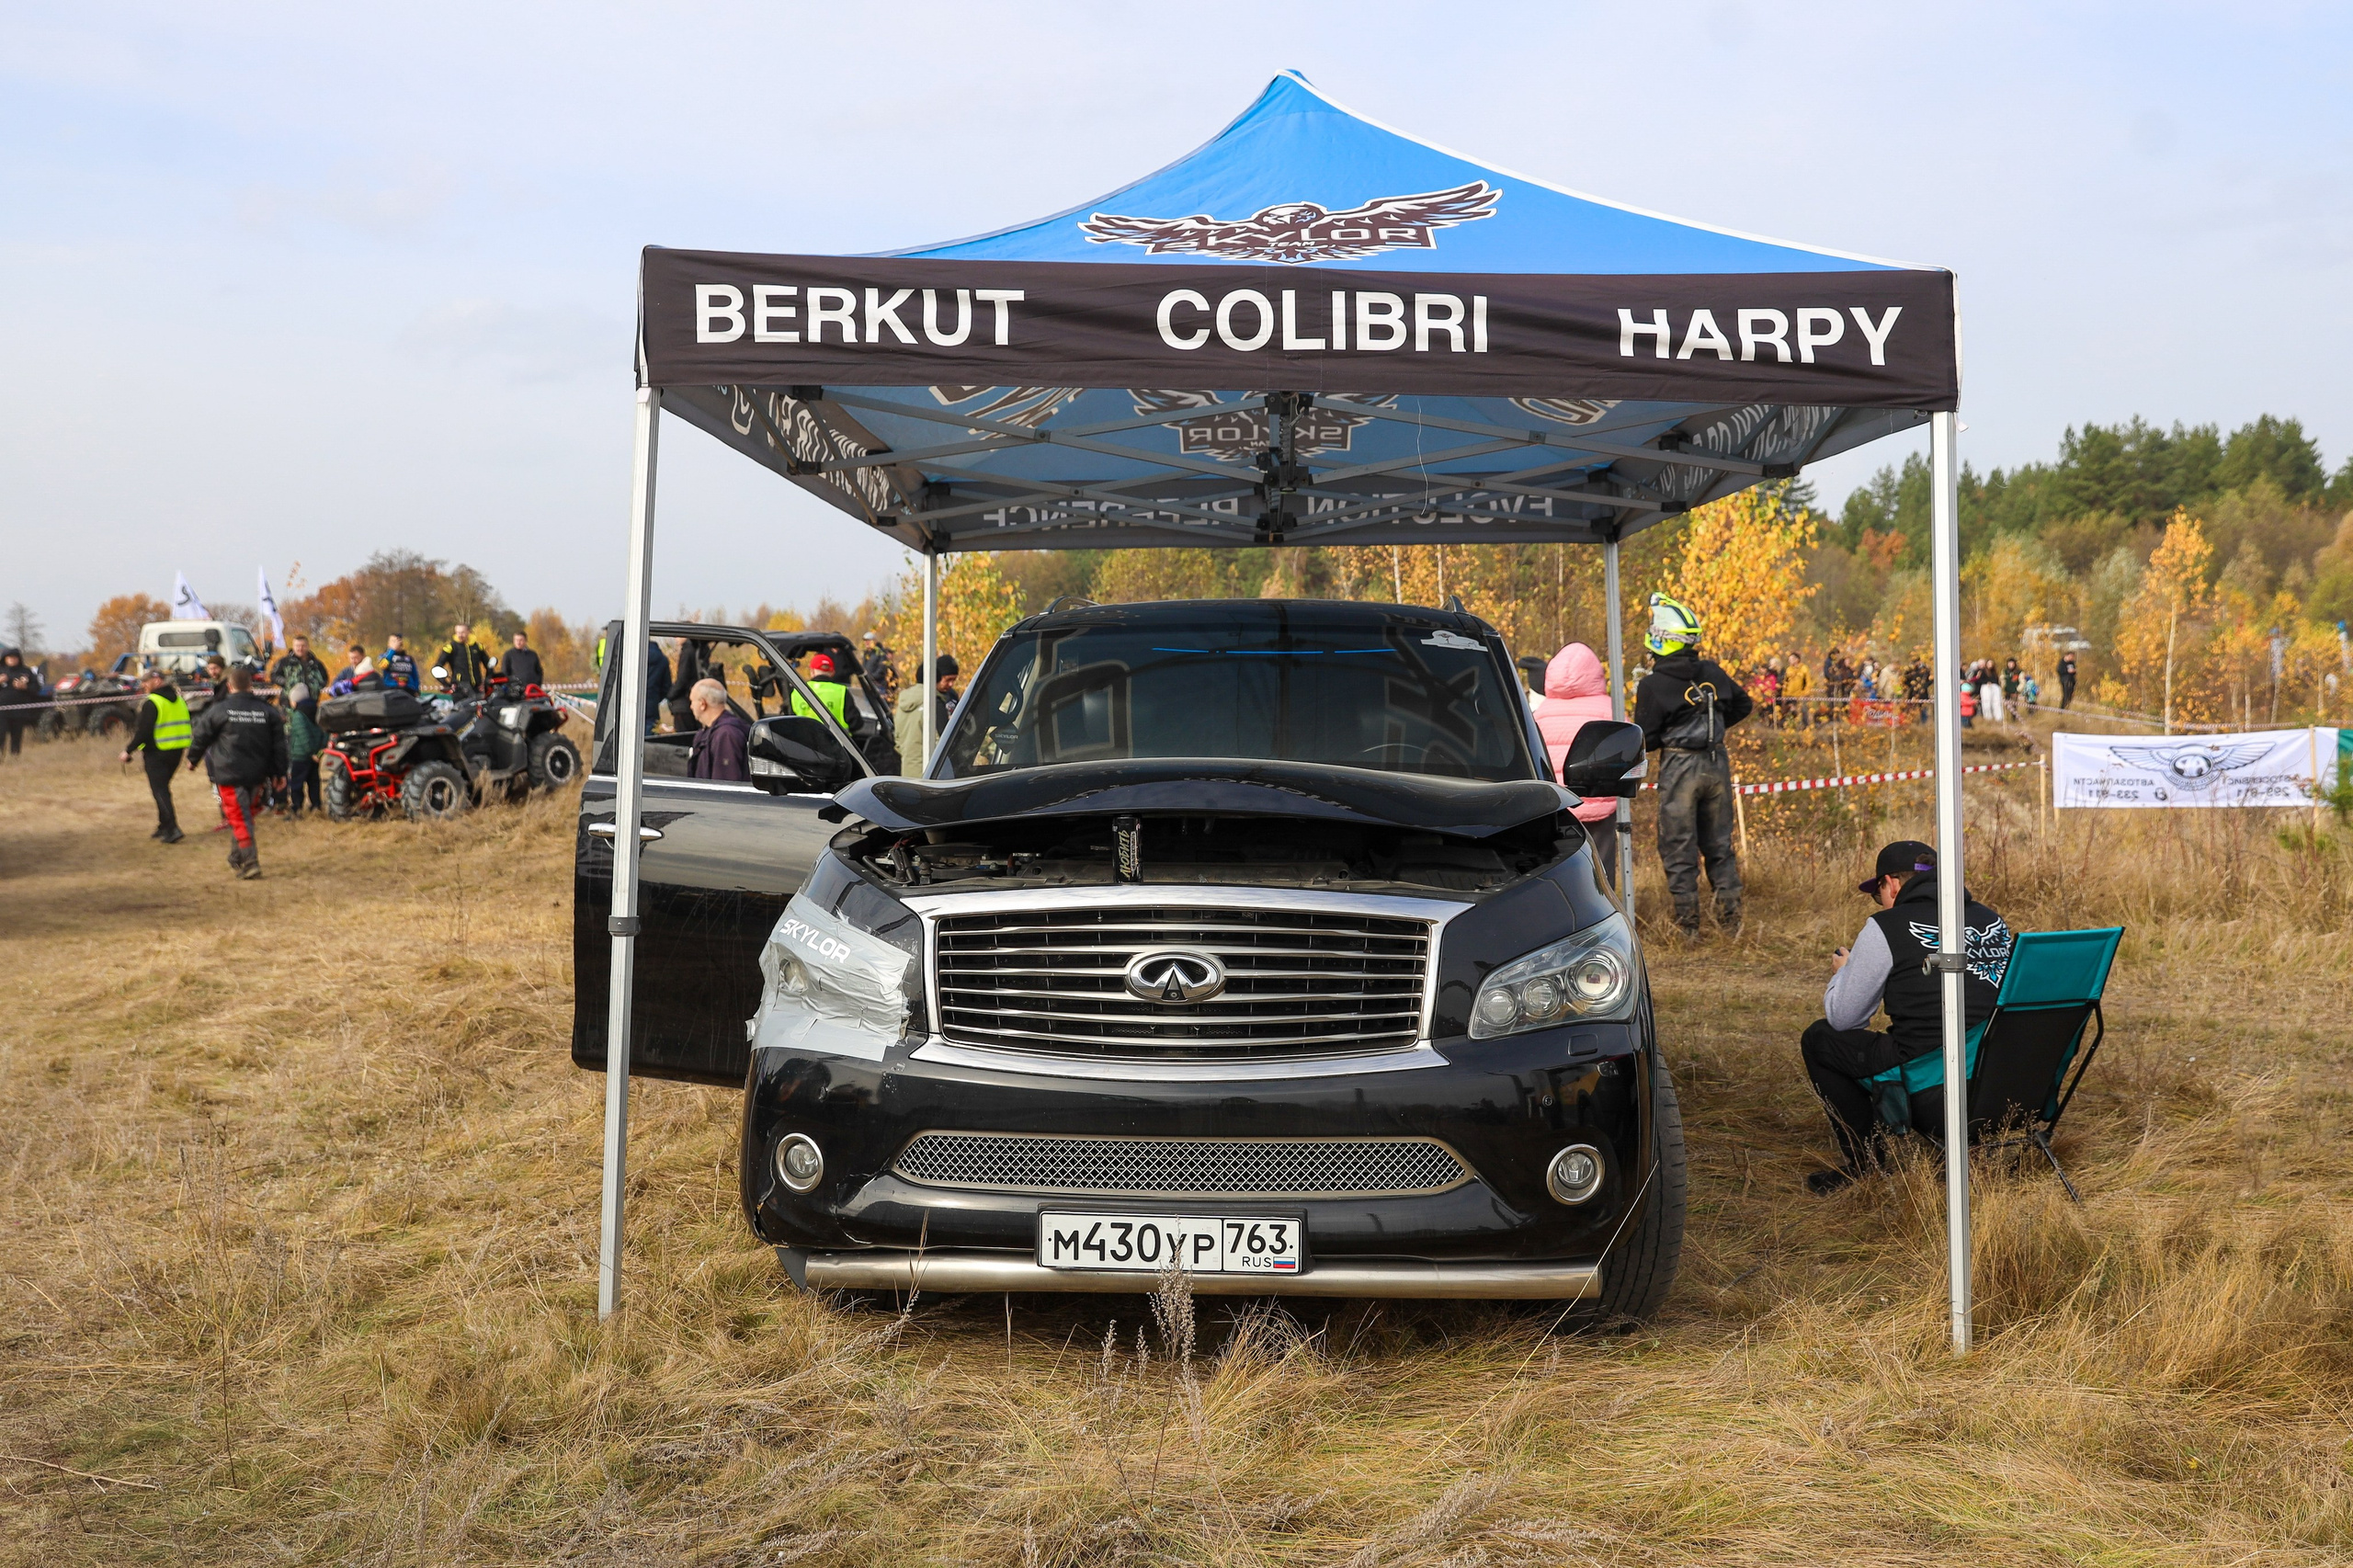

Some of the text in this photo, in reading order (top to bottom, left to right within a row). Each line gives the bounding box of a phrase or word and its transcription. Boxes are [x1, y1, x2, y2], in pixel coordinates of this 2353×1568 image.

[696, 283, 1904, 366] BERKUT COLIBRI HARPY
[779, 918, 851, 963] SKYLOR
[1967, 947, 2009, 959] KYLOR
[1226, 1223, 1288, 1255] 763
[1242, 1256, 1272, 1267] RUS
